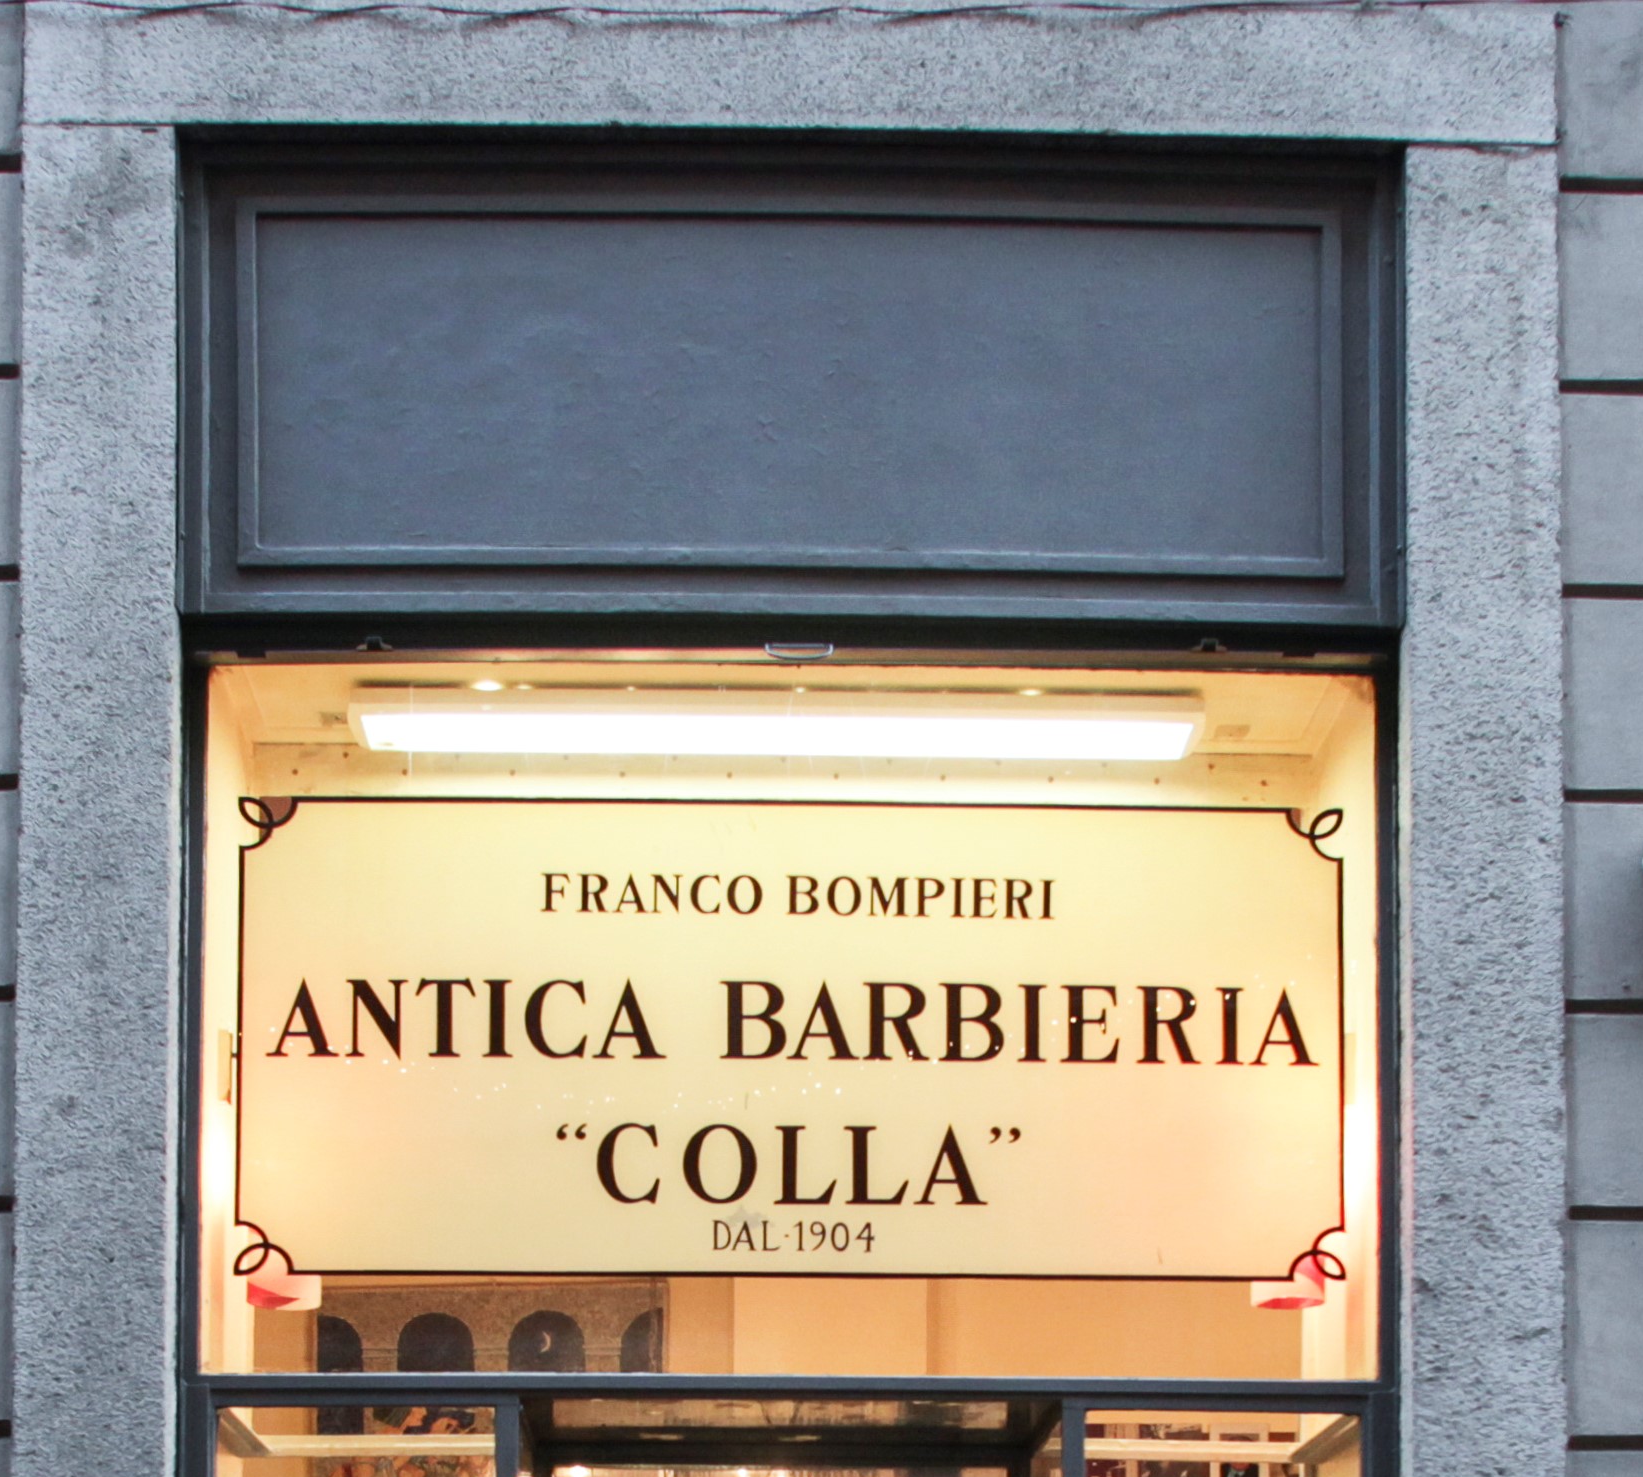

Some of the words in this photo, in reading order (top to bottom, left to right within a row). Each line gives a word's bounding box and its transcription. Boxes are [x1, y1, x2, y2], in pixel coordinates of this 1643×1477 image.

[541, 872, 762, 915] FRANCO
[786, 875, 1056, 919] BOMPIERI
[266, 977, 666, 1058] ANTICA
[719, 980, 1320, 1067] BARBIERIA
